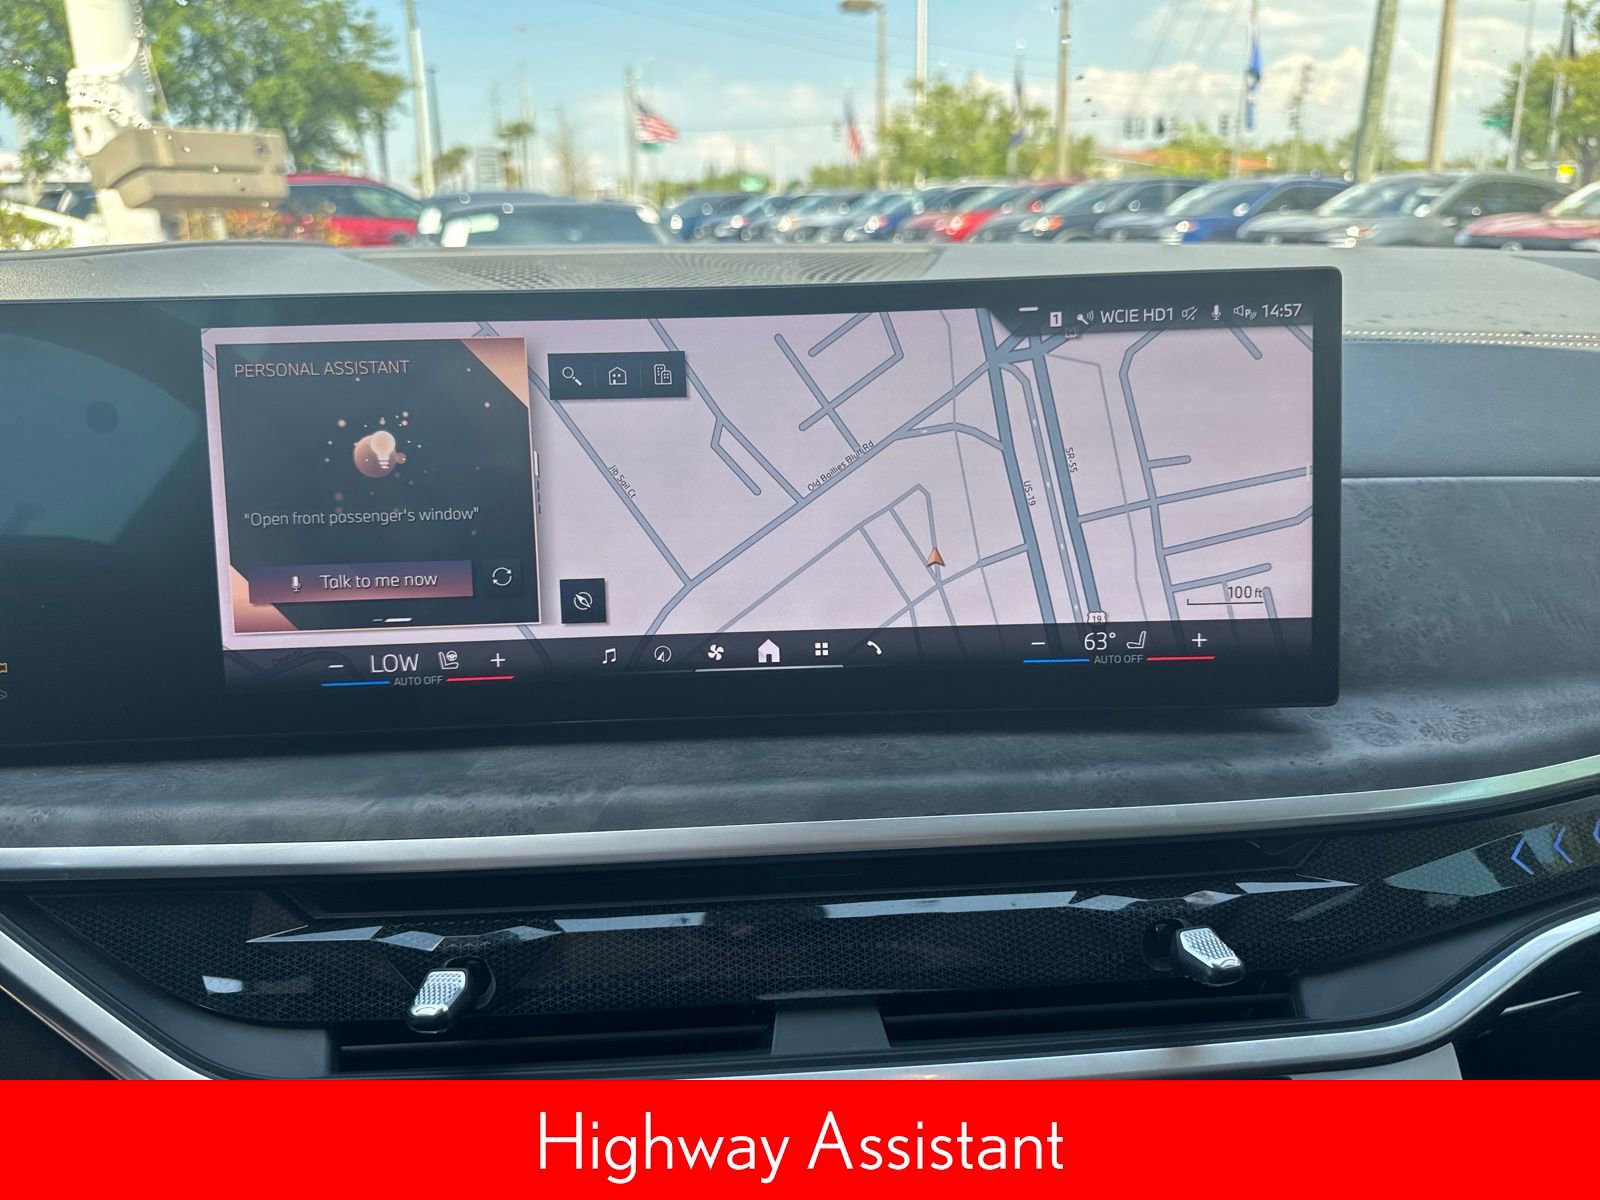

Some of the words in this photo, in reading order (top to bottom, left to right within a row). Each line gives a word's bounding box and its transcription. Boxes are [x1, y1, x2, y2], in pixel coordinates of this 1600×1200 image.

[1100, 309, 1139, 324] WCIE
[1143, 307, 1174, 322] HD1
[1261, 303, 1302, 319] 14:57
[234, 361, 320, 377] PERSONAL
[323, 359, 410, 376] ASSISTANT
[807, 478, 821, 491] Old
[862, 440, 875, 451] Rd
[1065, 446, 1078, 473] SR-55
[616, 474, 631, 490] Sail
[627, 488, 637, 499] Ct
[1023, 480, 1037, 506] US-19
[244, 512, 289, 527] "Open
[292, 511, 326, 525] front
[329, 508, 416, 526] passenger's
[418, 506, 479, 522] window"
[320, 573, 352, 590] Talk
[355, 575, 371, 588] to
[375, 575, 400, 588] me
[404, 574, 438, 587] now
[1227, 586, 1252, 599] 100
[1253, 586, 1263, 599] ft
[1091, 614, 1102, 624] 19
[1084, 631, 1117, 651] 63°
[370, 653, 419, 674] LOW
[1093, 654, 1121, 665] AUTO
[1123, 654, 1144, 664] OFF
[393, 676, 422, 687] AUTO
[423, 675, 444, 686] OFF
